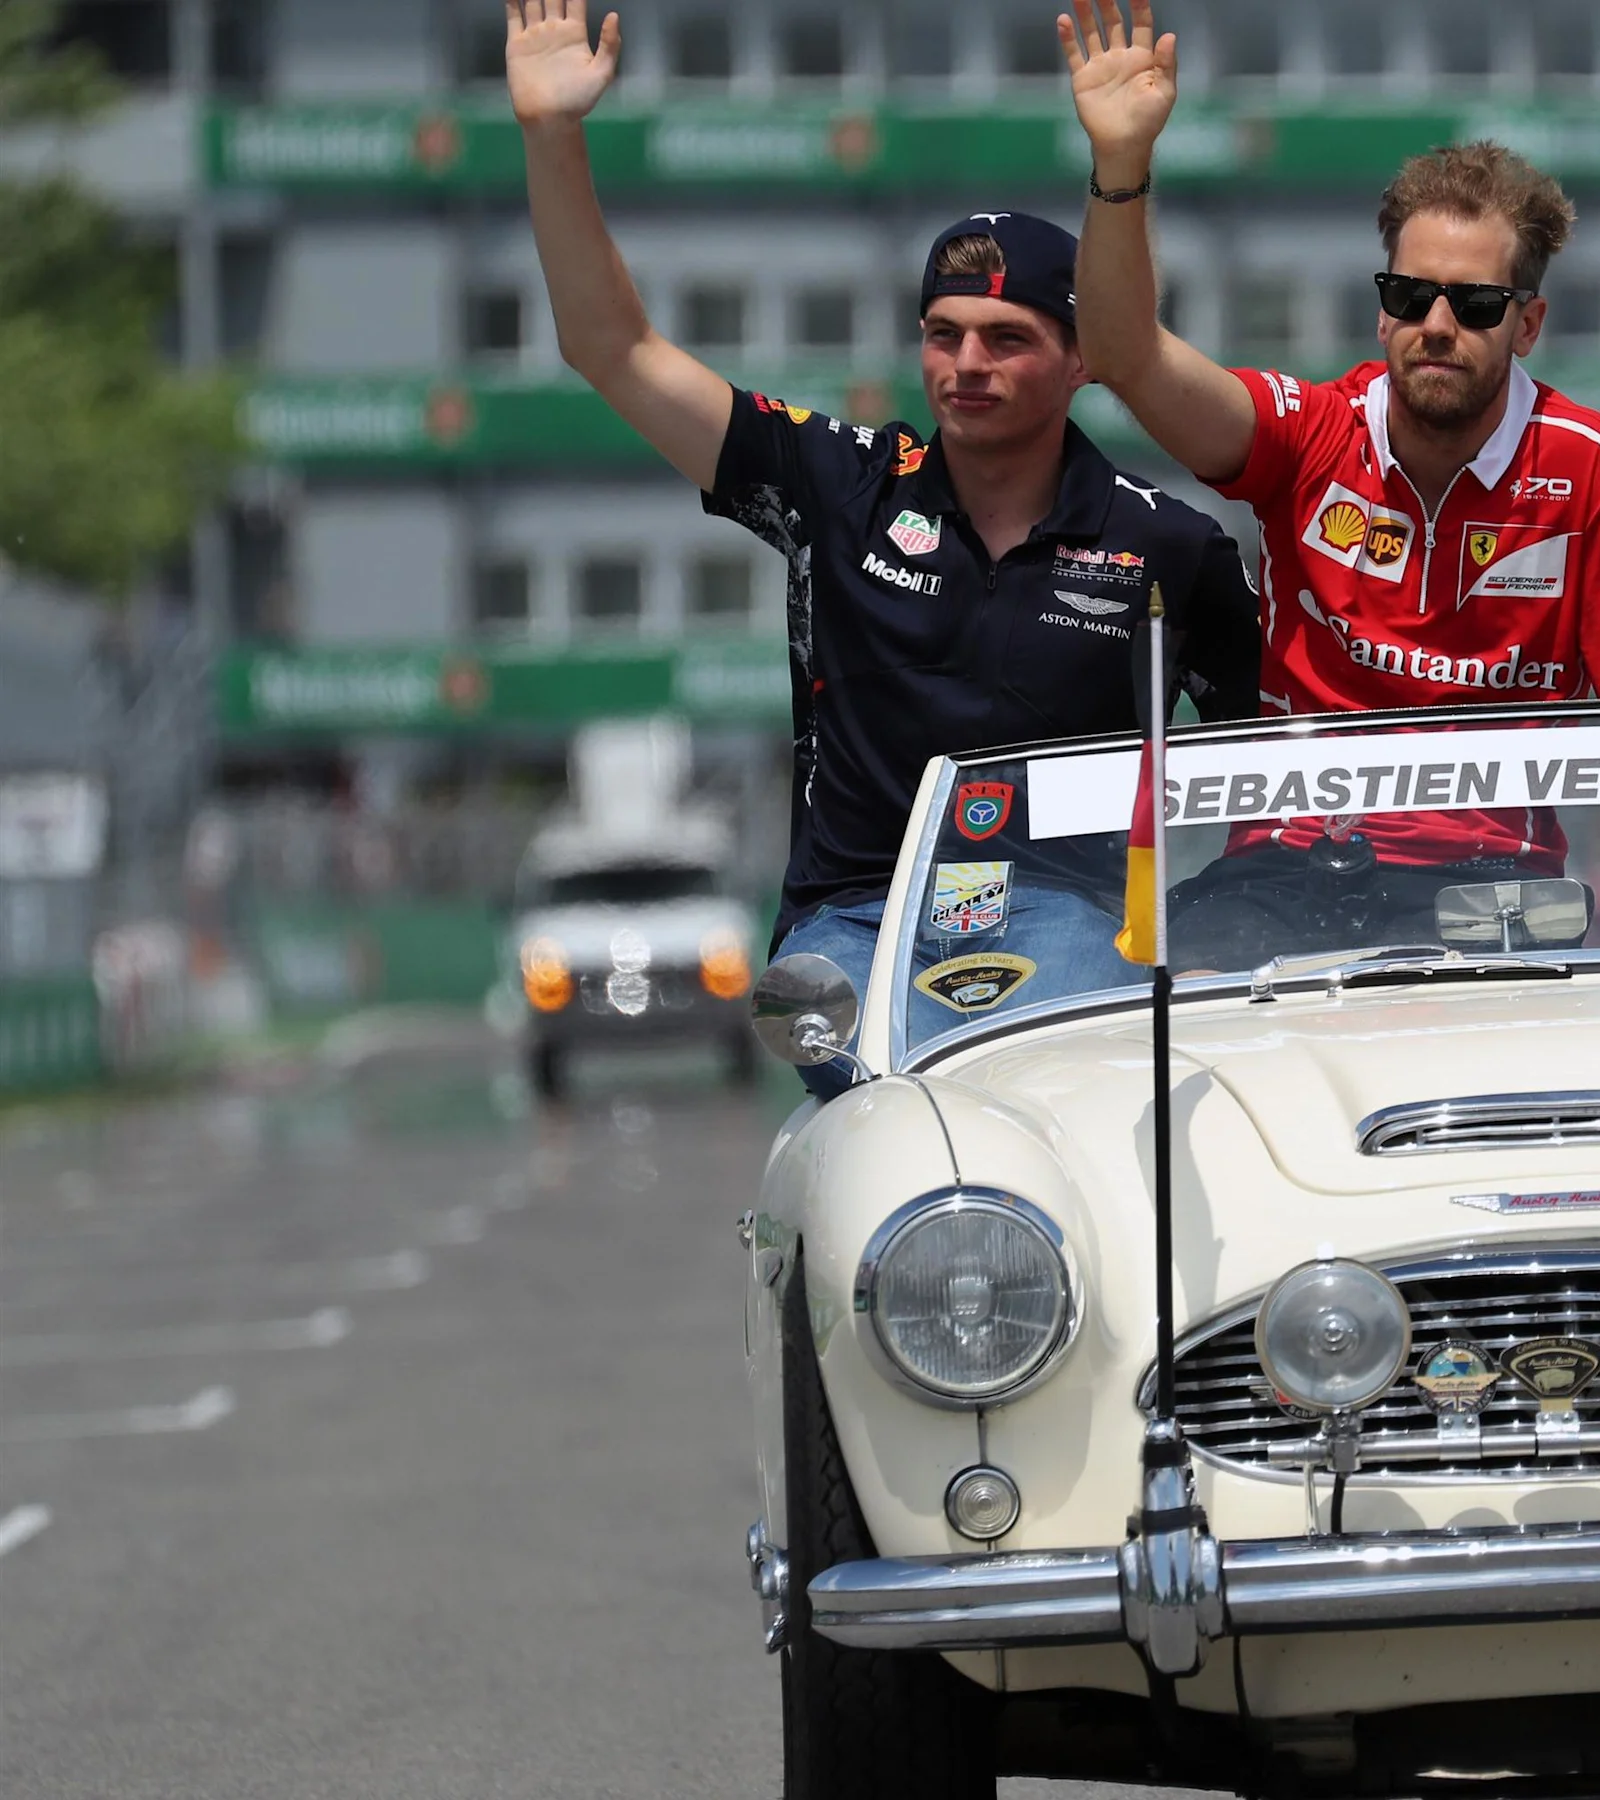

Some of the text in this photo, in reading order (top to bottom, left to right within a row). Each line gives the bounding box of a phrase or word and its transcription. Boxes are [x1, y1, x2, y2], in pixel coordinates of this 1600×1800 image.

[1524, 476, 1573, 496] 70
[1367, 529, 1404, 560] ups
[861, 551, 924, 593] Mobil
[1053, 558, 1143, 578] RACING
[1487, 576, 1543, 584] SCUDERIA
[1507, 583, 1555, 591] FERRARI
[1038, 612, 1131, 640] ASTON MARTIN
[1326, 615, 1565, 690] Santander
[1164, 761, 1501, 821] SEBASTIEN
[935, 885, 1003, 922] HEALEY
[930, 955, 1014, 976] Celebrating 50 Years
